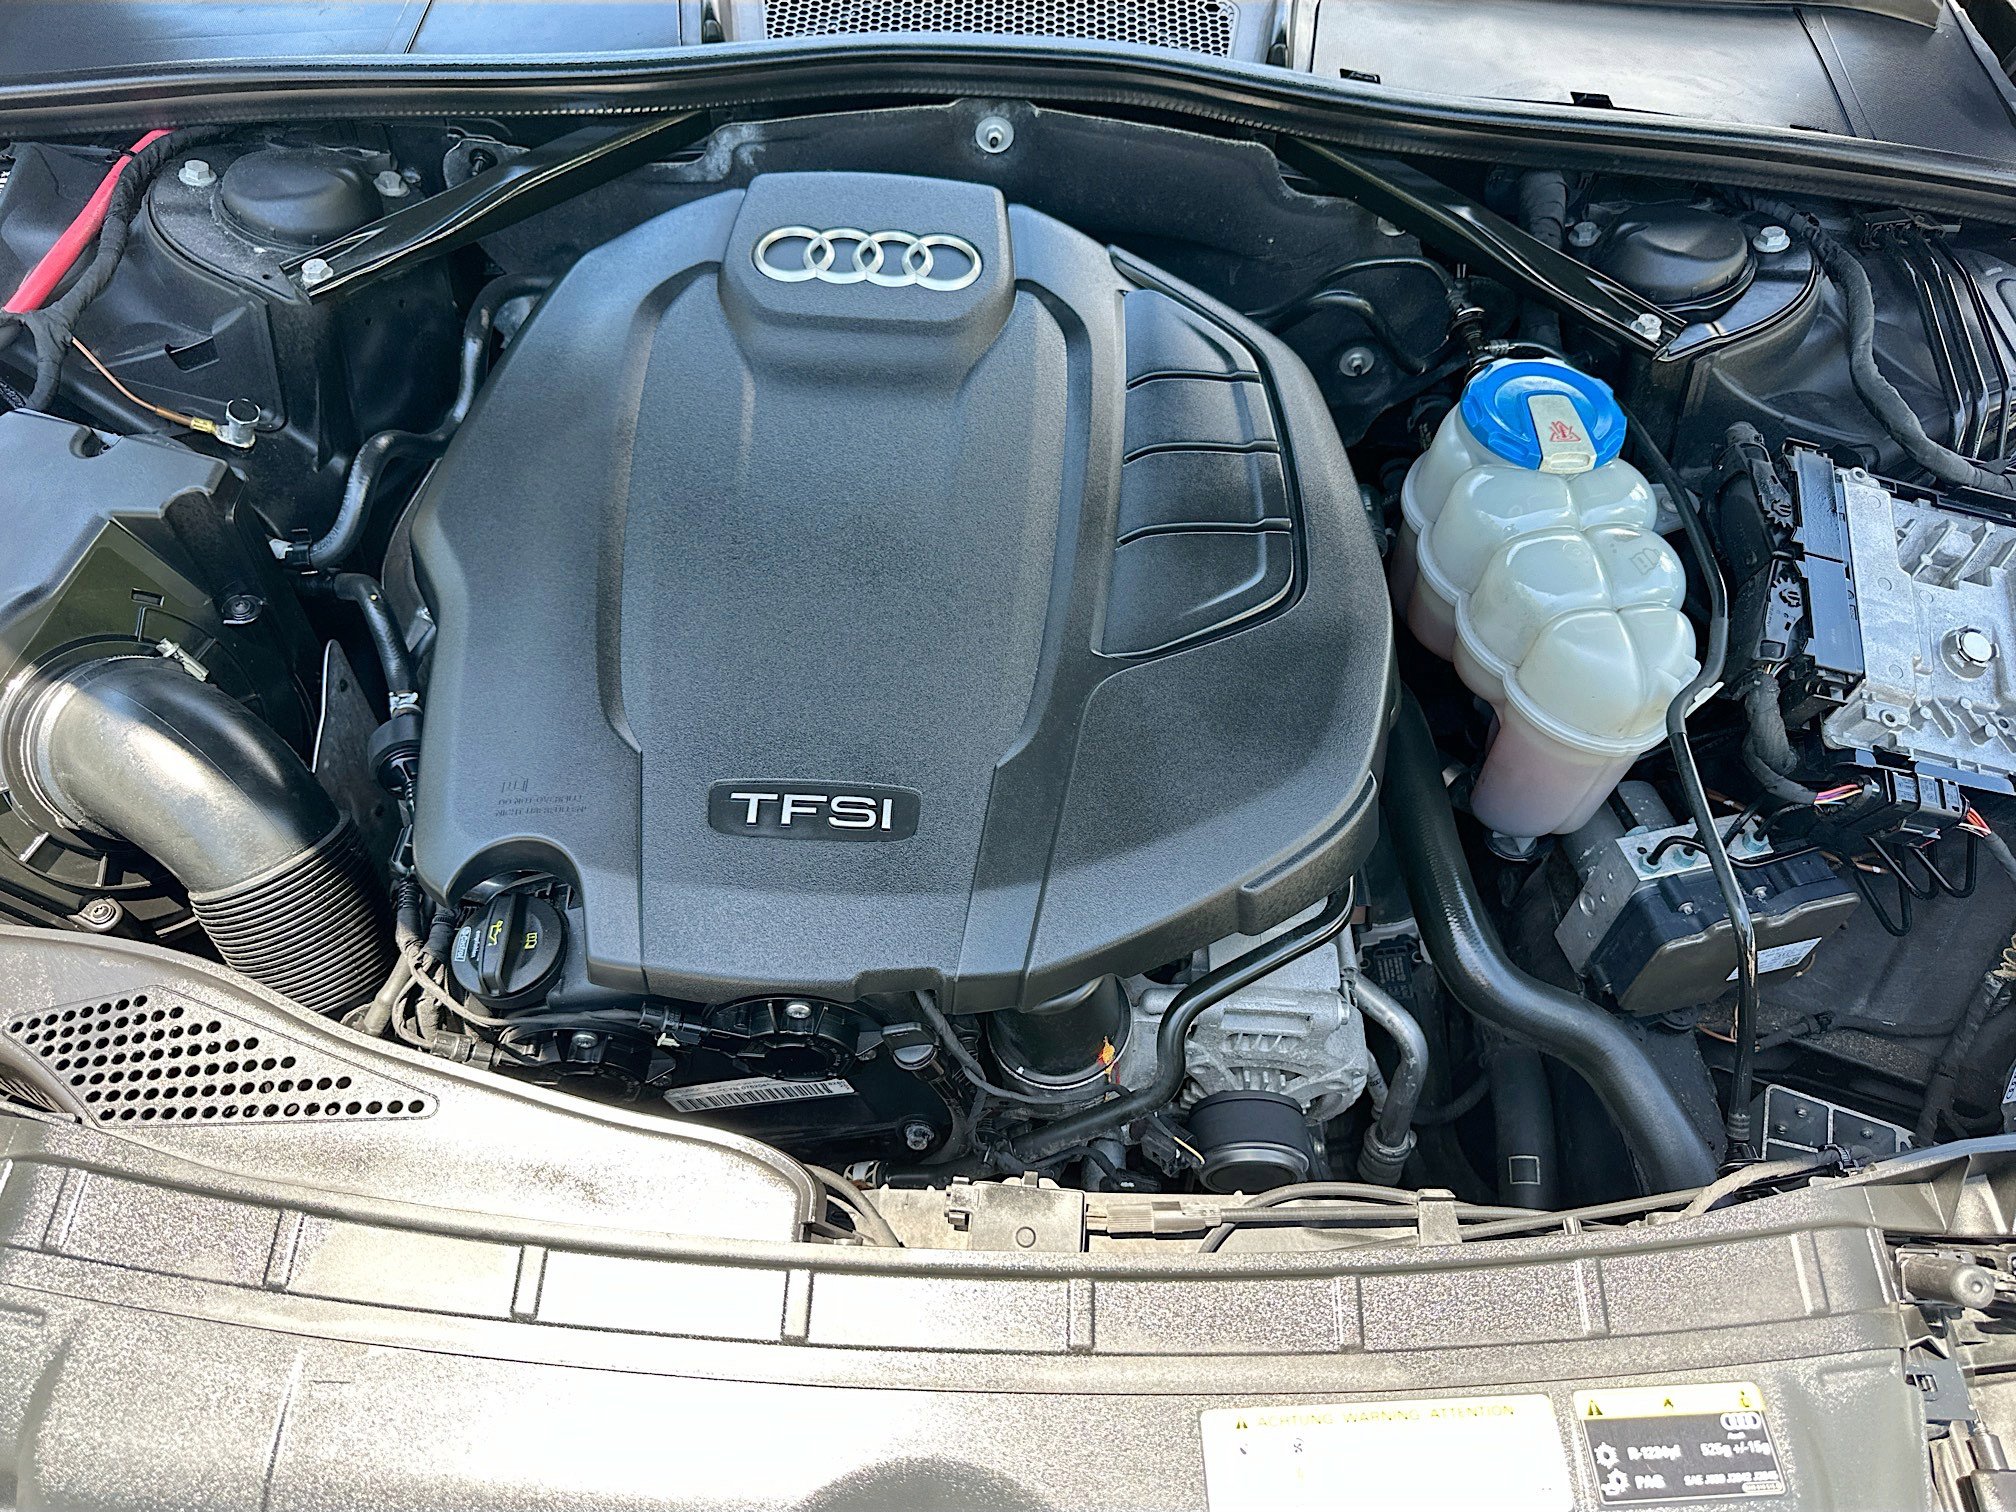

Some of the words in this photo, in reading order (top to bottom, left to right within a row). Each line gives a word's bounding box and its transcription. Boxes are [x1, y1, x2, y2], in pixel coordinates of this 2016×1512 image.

[730, 790, 894, 831] TFSI
[457, 936, 468, 958] Castrol
[1257, 1414, 1334, 1427] ACHTUNG
[1344, 1410, 1420, 1422] WARNING
[1431, 1405, 1515, 1419] ATTENTION
